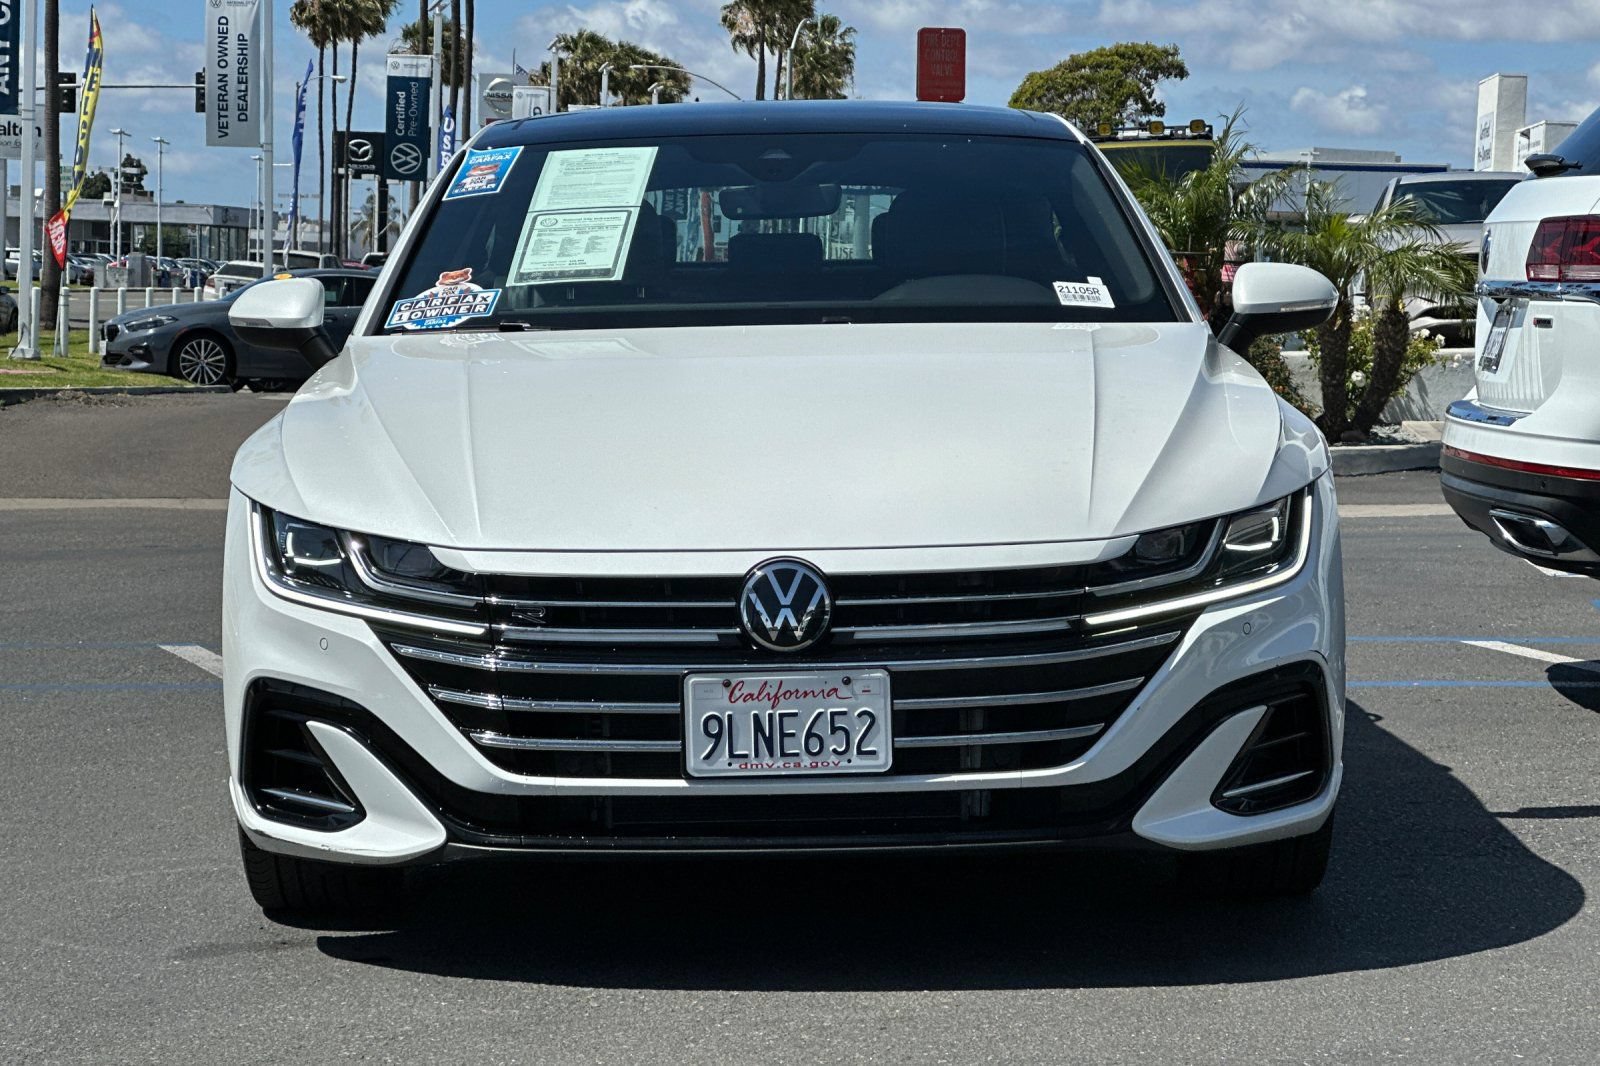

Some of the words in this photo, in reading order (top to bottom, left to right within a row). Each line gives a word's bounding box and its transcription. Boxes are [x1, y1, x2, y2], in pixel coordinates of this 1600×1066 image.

[217, 15, 229, 69] OWNED
[237, 33, 249, 123] DEALERSHIP
[0, 120, 42, 137] altn
[217, 73, 229, 139] VETERAN
[395, 91, 406, 136] Certified
[408, 81, 419, 137] Pre-Owned
[441, 116, 455, 165] USE
[400, 295, 492, 312] CARFAX
[410, 304, 487, 320] OWNER
[1057, 285, 1101, 296] 21105R
[728, 679, 852, 710] California
[700, 708, 878, 761] 9LNE652
[738, 760, 842, 771] dmv.ca.gov
